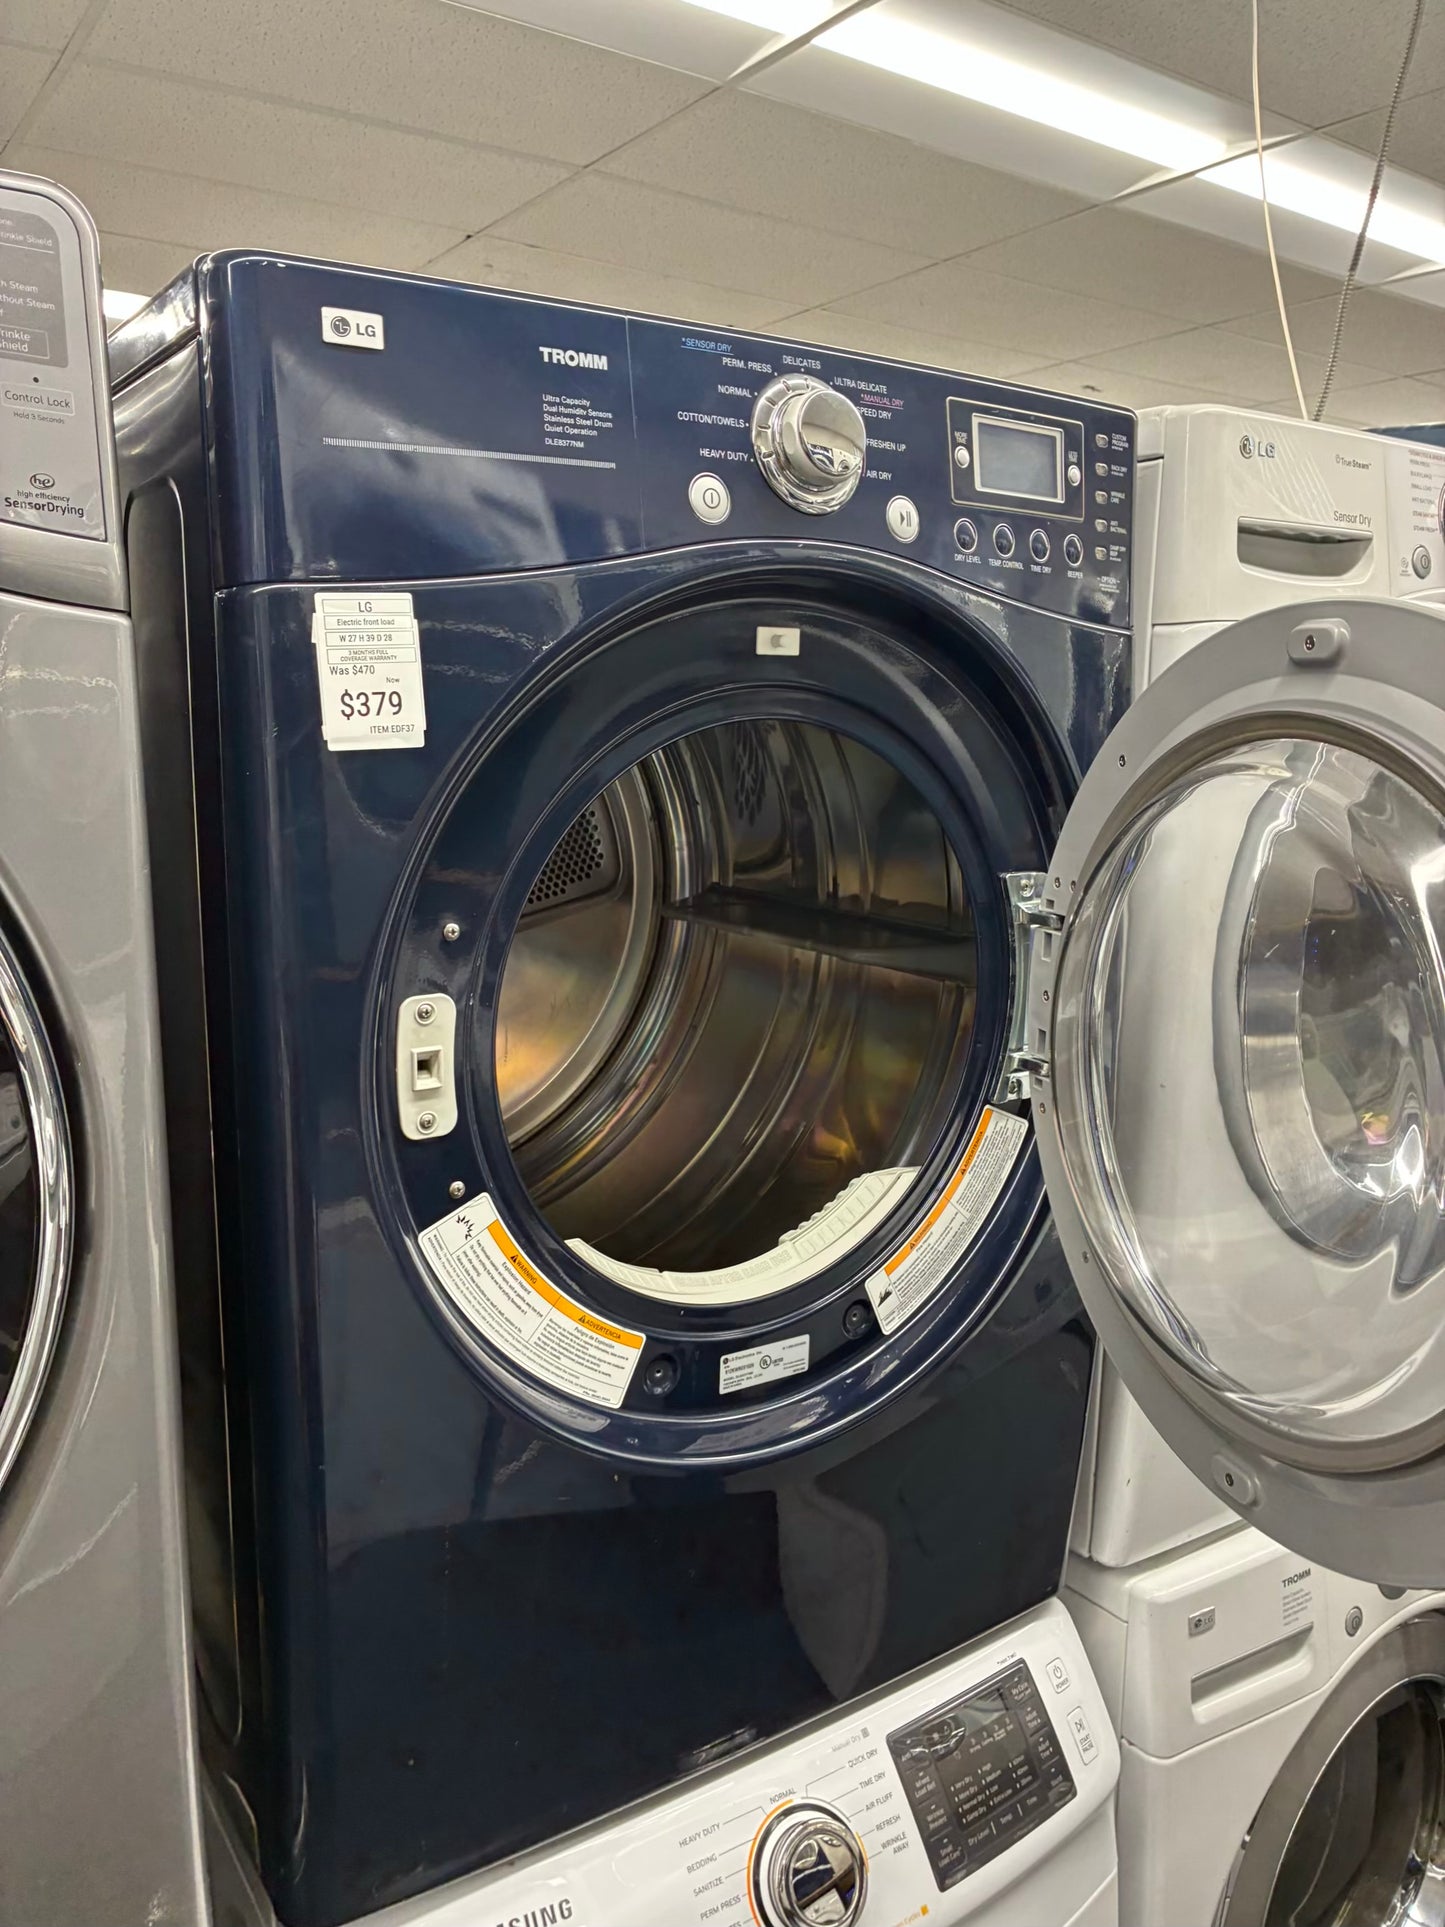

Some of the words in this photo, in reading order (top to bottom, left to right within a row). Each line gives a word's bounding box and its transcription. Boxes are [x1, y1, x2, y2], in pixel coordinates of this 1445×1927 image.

[0, 230, 24, 241] rinkle
[26, 233, 53, 247] Shield
[9, 280, 39, 293] Steam
[0, 294, 24, 305] thout
[26, 297, 56, 311] Steam
[0, 328, 31, 341] rinkle
[356, 322, 377, 338] LG
[717, 342, 733, 353] DRY
[539, 346, 609, 371] TROMM
[722, 356, 747, 370] PERM.
[748, 360, 773, 374] PRESS
[783, 354, 822, 370] DELICATES
[718, 384, 752, 398] NORMAL
[834, 376, 857, 389] ULTRA
[857, 380, 888, 394] DELICATE
[4, 389, 44, 405] Control
[47, 397, 71, 408] Lock
[542, 394, 560, 403] Ultra
[561, 396, 590, 408] Capacity
[891, 398, 905, 408] DRY
[13, 410, 30, 420] Hold
[31, 412, 37, 420] 3
[38, 415, 65, 425] Seconds
[543, 403, 558, 413] Dual
[559, 405, 587, 417] Humidity
[588, 408, 614, 419] Sensors
[878, 410, 892, 420] DRY
[544, 413, 575, 425] Stainless
[576, 416, 593, 427] Steel
[594, 418, 614, 429] Drum
[677, 411, 745, 428] COTTON/TOWELS
[544, 423, 563, 433] Quiet
[564, 425, 598, 437] Operation
[866, 438, 896, 451] FRESHEN
[896, 442, 907, 452] UP
[1258, 441, 1276, 458] LG
[700, 447, 725, 460] HEAVY
[726, 451, 748, 462] DUTY
[866, 469, 877, 479] AIR
[878, 471, 892, 481] DRY
[17, 489, 34, 499] high
[35, 492, 70, 504] efficiency
[4, 496, 85, 518] SensorDrying
[1333, 510, 1357, 524] Sensor
[1358, 514, 1372, 528] Dry
[954, 553, 965, 562] DRY
[966, 555, 982, 564] LEVEL
[1002, 559, 1024, 570] CONTROL
[1030, 564, 1041, 573] TIME
[1042, 565, 1052, 574] DRY
[1067, 570, 1083, 579] BEEPER
[358, 601, 373, 613] LG
[337, 617, 362, 627] Electric
[363, 618, 379, 626] front
[380, 617, 395, 626] load
[339, 634, 347, 643] W
[348, 633, 357, 643] 27
[358, 633, 365, 642] H
[366, 633, 375, 642] 39
[377, 633, 382, 642] D
[383, 632, 393, 642] 28
[329, 665, 350, 676] Was
[352, 664, 375, 676] $470
[386, 676, 400, 684] Now
[340, 688, 403, 721] $379
[370, 725, 389, 734] ITEM
[391, 723, 415, 733] EDF37
[516, 1260, 537, 1284] WARNING
[586, 1319, 621, 1340] ADVERTENCIA
[1282, 1568, 1311, 1588] TROMM
[1055, 1677, 1069, 1690] POWER
[1079, 1733, 1091, 1744] START
[848, 1754, 866, 1768] QUICK
[866, 1748, 878, 1760] DRY
[858, 1778, 873, 1790] TIME
[872, 1771, 886, 1784] DRY
[964, 1775, 973, 1784] Dry
[769, 1787, 797, 1805] NORMAL
[969, 1785, 978, 1794] Dry
[865, 1801, 876, 1812] AIR
[875, 1792, 894, 1808] FLUFF
[977, 1793, 986, 1803] Dry
[978, 1806, 987, 1815] Dry
[875, 1814, 902, 1832] REFRESH
[679, 1831, 702, 1848] HEAVY
[702, 1822, 721, 1839] DUTY
[880, 1832, 907, 1850] WRINKLE
[968, 1836, 978, 1847] Dry
[892, 1842, 910, 1855] AWAY
[686, 1853, 718, 1874] BEDDING
[693, 1876, 724, 1897] SANITIZE
[700, 1904, 719, 1921] PERM
[720, 1894, 742, 1911] PRESS
